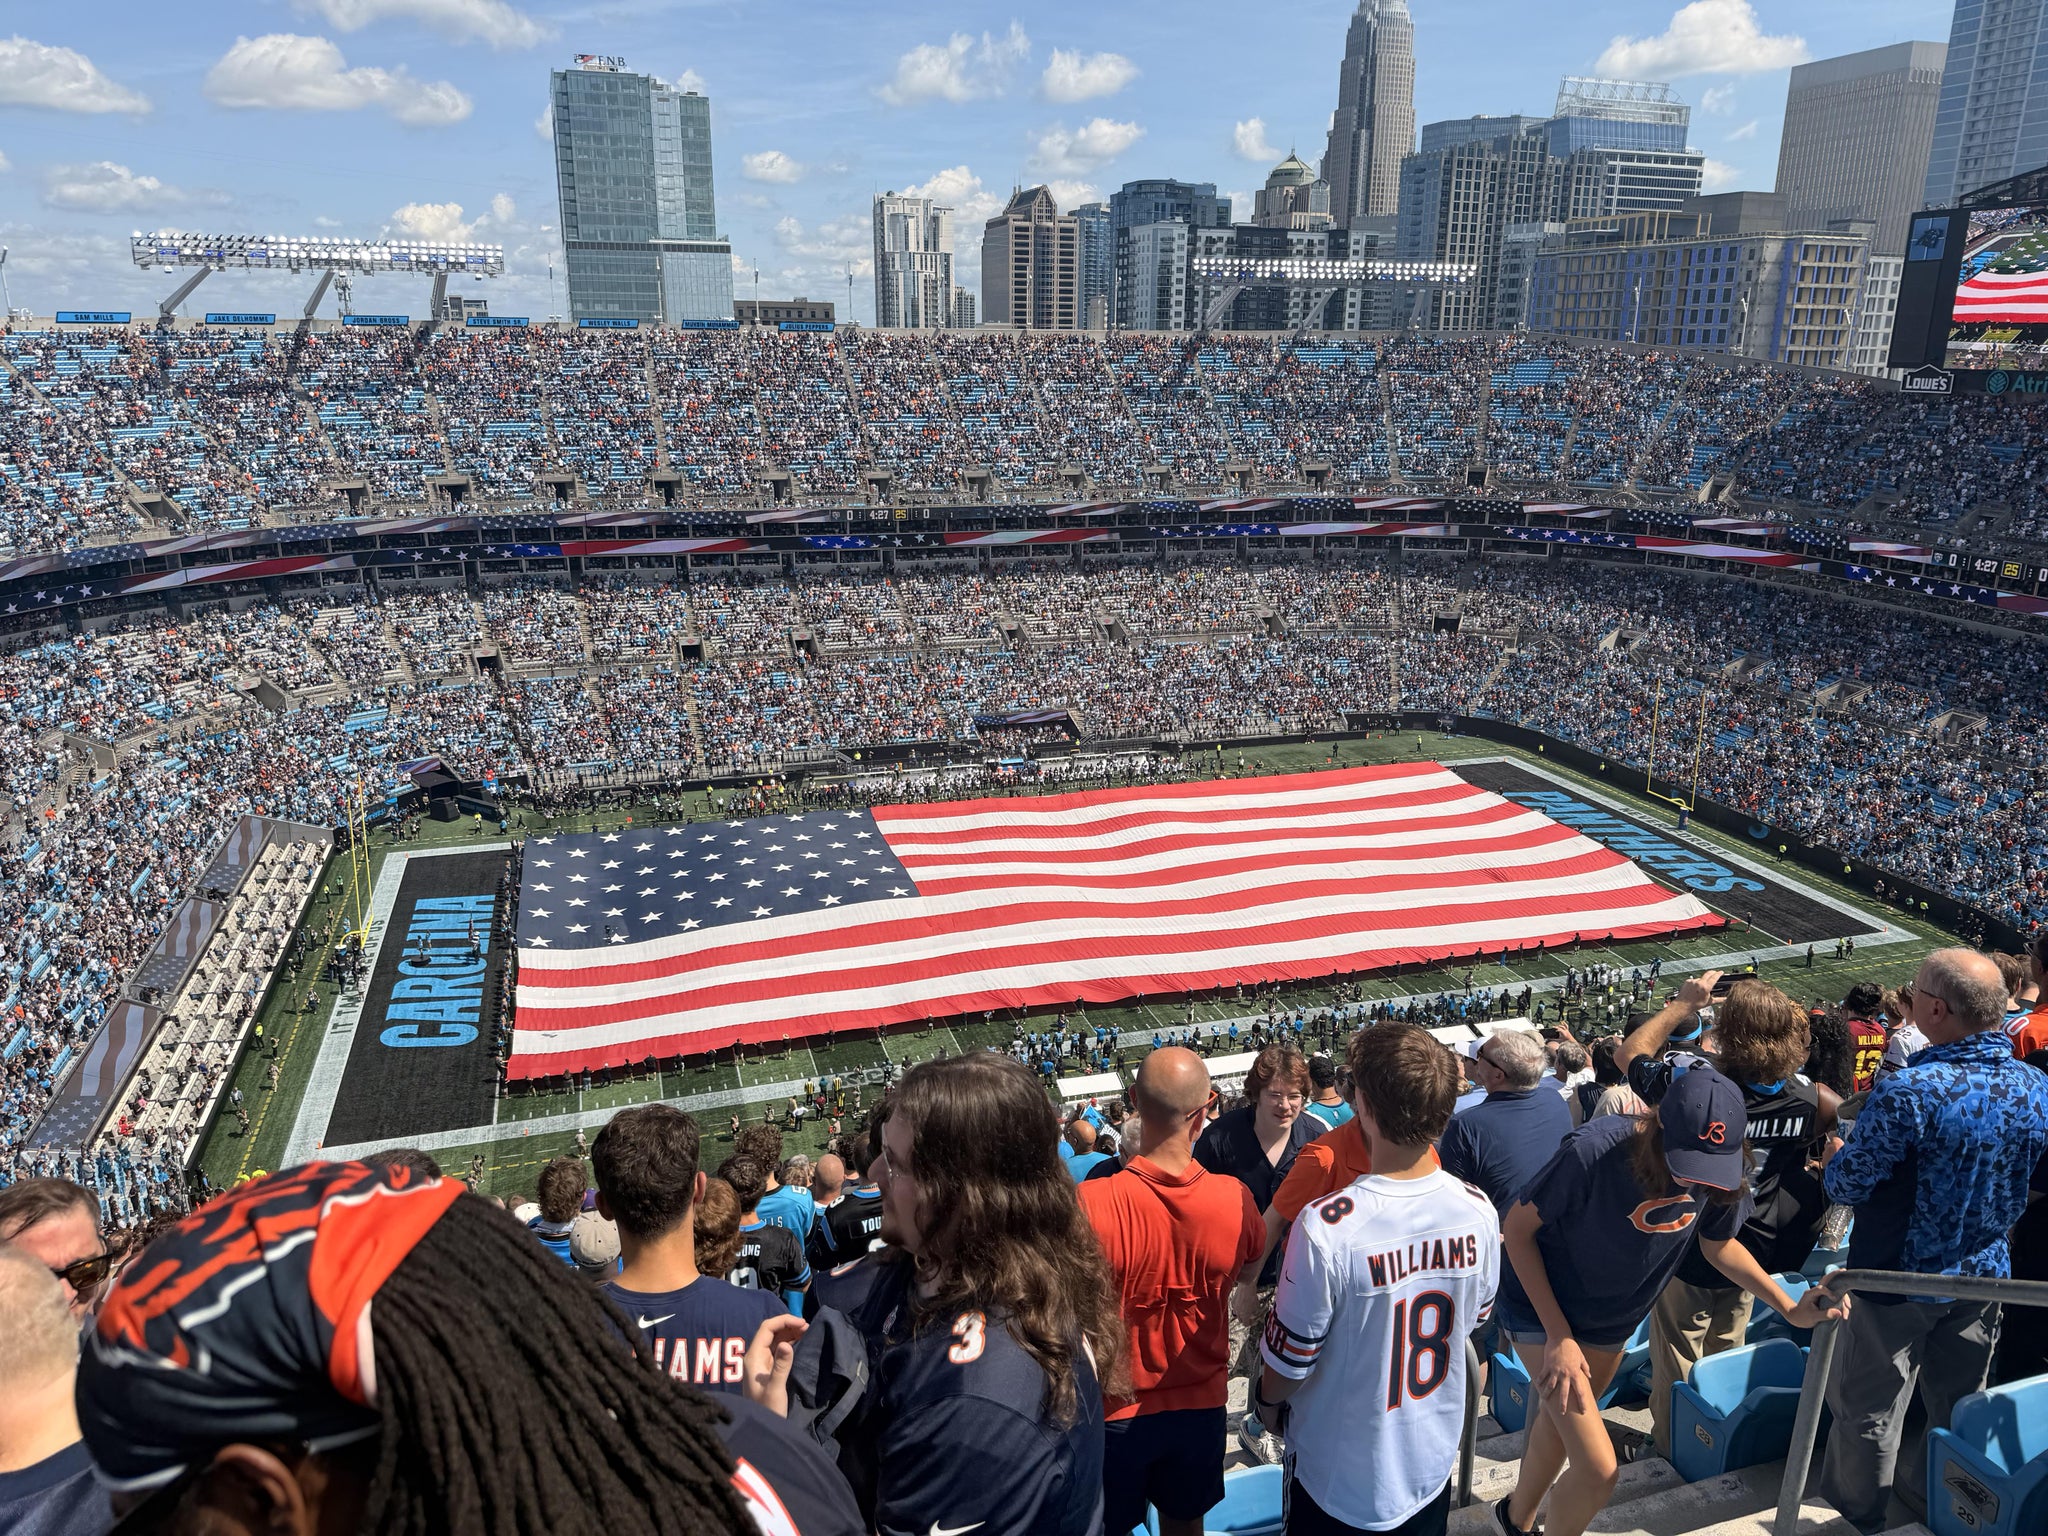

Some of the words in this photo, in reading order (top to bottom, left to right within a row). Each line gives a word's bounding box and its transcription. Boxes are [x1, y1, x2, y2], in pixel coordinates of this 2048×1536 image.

[74, 313, 91, 321] SAM
[94, 313, 114, 321] MILLS
[214, 314, 230, 323] JAKE
[232, 314, 268, 323] DELHOMME
[1905, 376, 1948, 391] LOWE'S
[869, 510, 889, 520] 4:27
[1948, 553, 1958, 567] 0
[1974, 558, 1999, 573] 4:27
[2003, 563, 2019, 577] 25
[1620, 807, 1672, 831] NEVER
[1503, 791, 1766, 893] PANTHERS
[379, 894, 495, 1048] CAROLINA
[331, 1021, 354, 1035] IT
[1858, 1034, 1884, 1046] WILLIAMS
[861, 1216, 884, 1234] YOU
[1366, 1234, 1476, 1288] WILLIAMS
[1386, 1289, 1455, 1412] 18
[1957, 1506, 1975, 1526] 29
